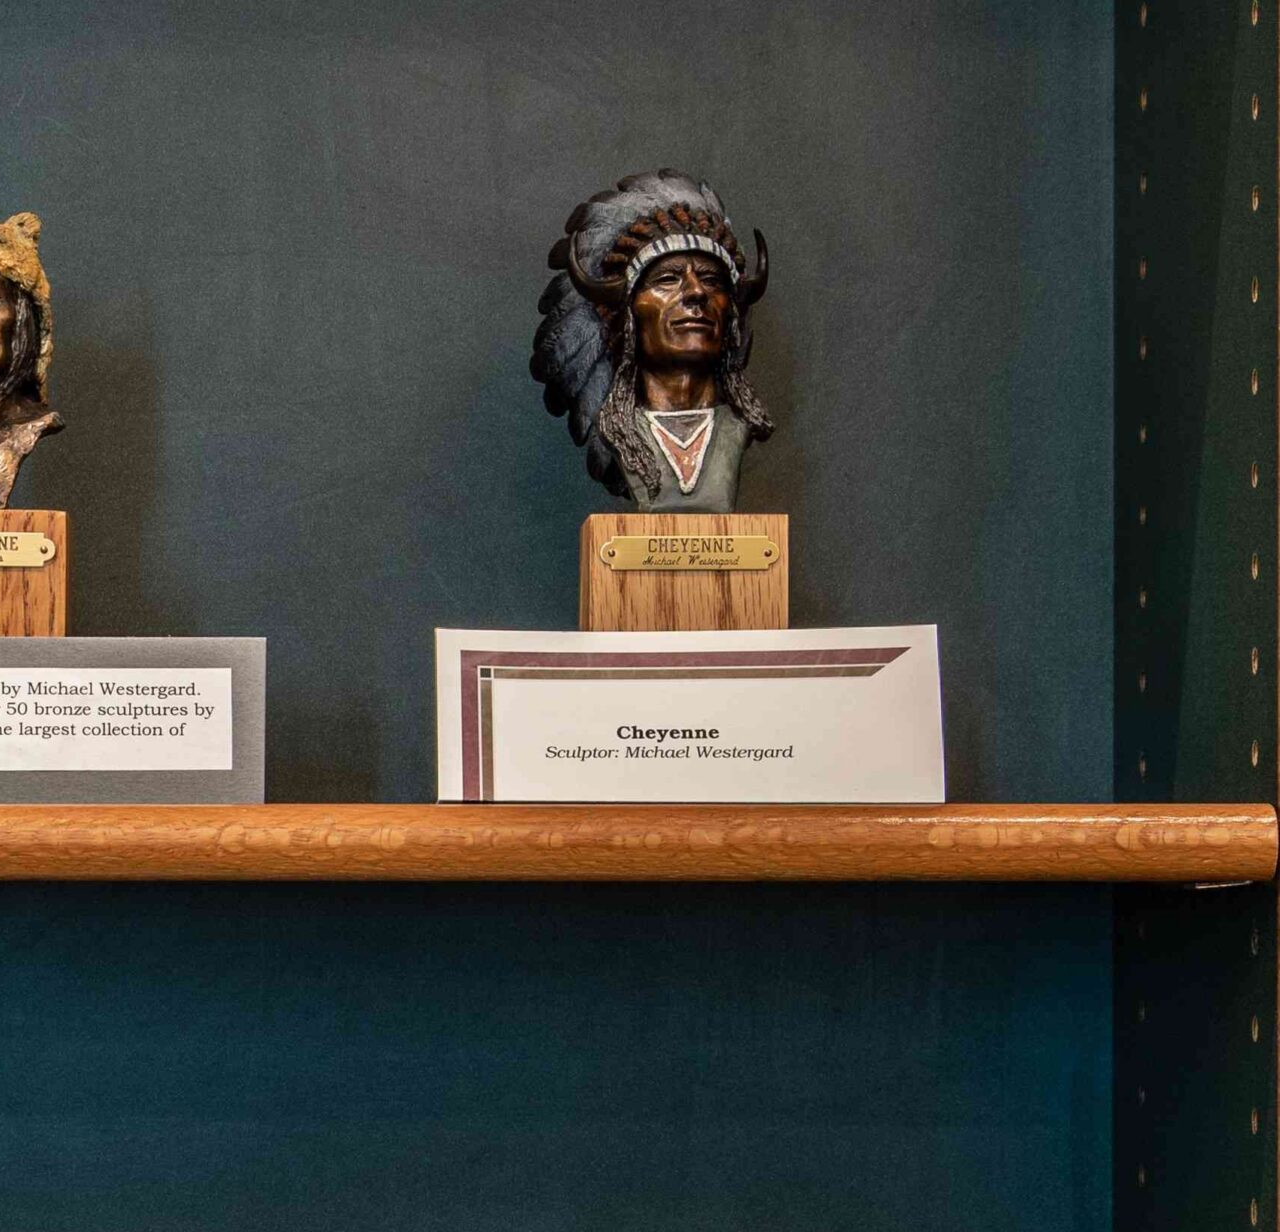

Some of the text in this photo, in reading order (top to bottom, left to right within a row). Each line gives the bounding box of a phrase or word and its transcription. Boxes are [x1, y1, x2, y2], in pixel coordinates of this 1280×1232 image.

[648, 537, 735, 553] CHEYENNE
[1, 681, 22, 699] by
[27, 681, 94, 696] Michael
[99, 682, 202, 699] Westergard.
[6, 703, 28, 716] 50
[34, 702, 92, 717] bronze
[97, 702, 189, 720] sculptures
[194, 702, 215, 720] by
[18, 722, 77, 740] largest
[81, 722, 163, 737] collection
[168, 722, 187, 737] of
[616, 724, 720, 743] Cheyenne
[545, 745, 794, 763] Sculptor: Michael Westergard
